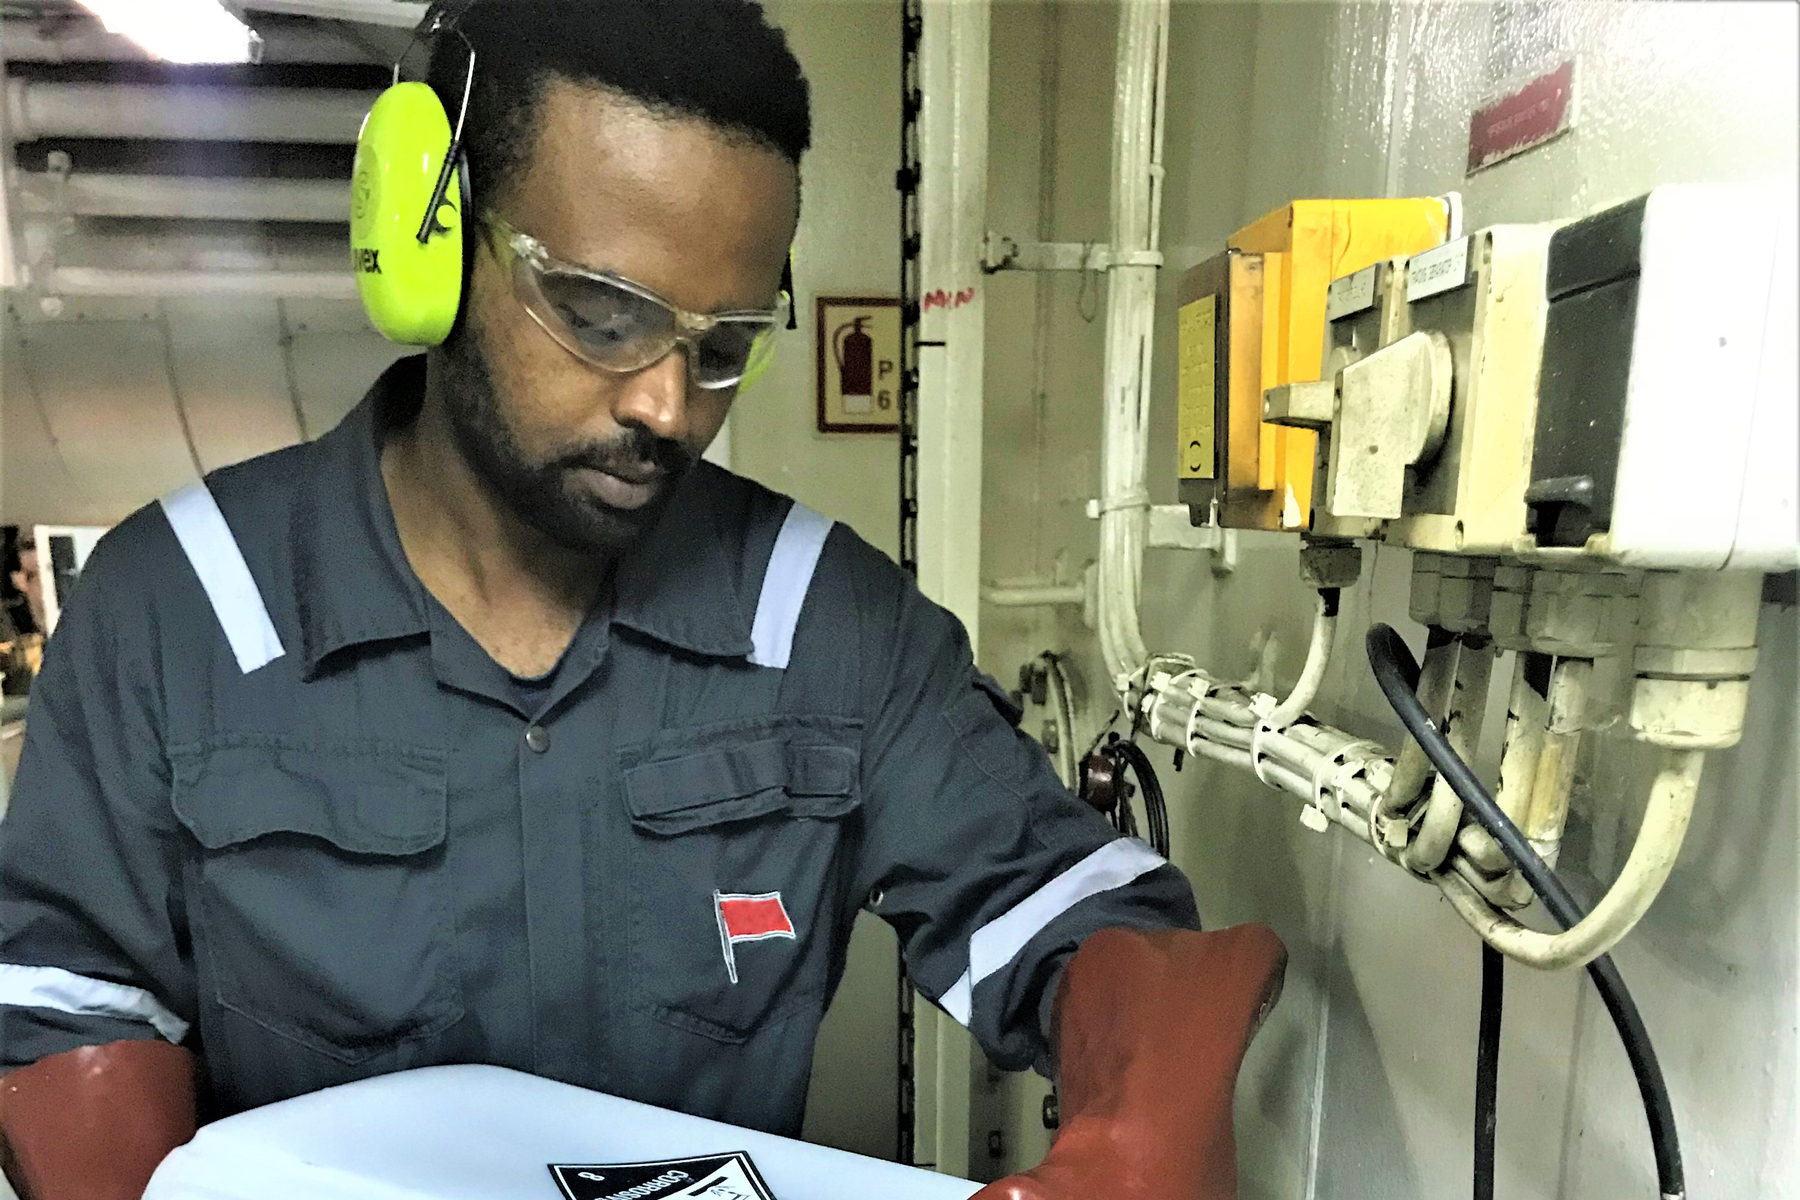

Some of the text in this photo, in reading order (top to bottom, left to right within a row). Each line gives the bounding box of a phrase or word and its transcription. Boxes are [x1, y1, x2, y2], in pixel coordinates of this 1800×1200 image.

[878, 361, 893, 380] P
[877, 390, 891, 410] 6
[578, 1171, 605, 1181] 8
